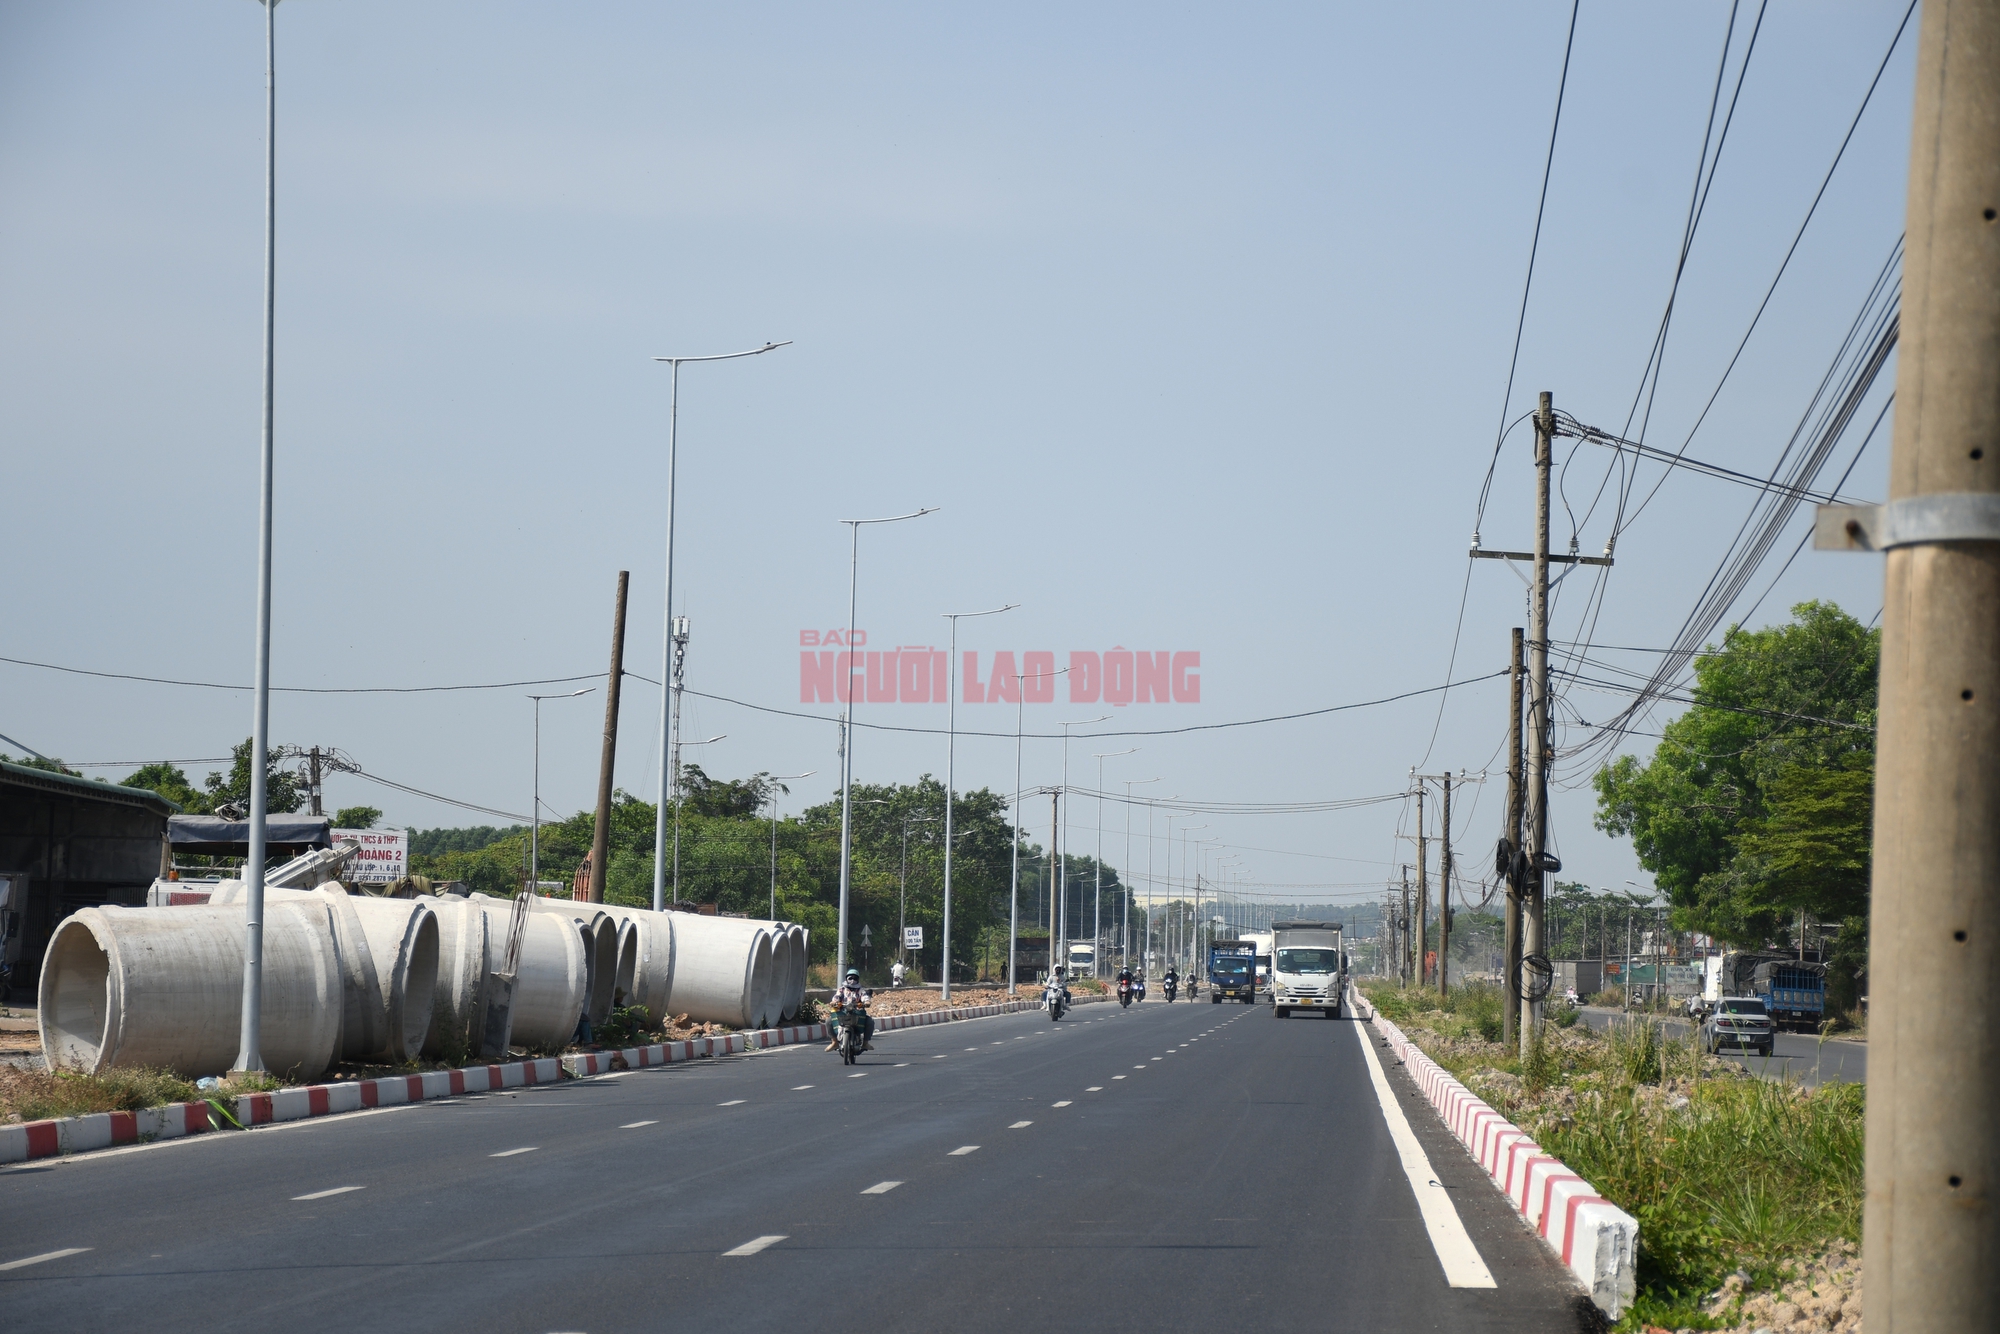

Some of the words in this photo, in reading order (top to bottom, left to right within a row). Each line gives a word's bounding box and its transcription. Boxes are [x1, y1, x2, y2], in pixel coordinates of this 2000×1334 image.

[361, 835, 376, 844] THCS
[377, 836, 383, 844] &
[384, 836, 398, 844] THPT
[358, 848, 392, 860] HOÀNG
[395, 850, 402, 861] 2
